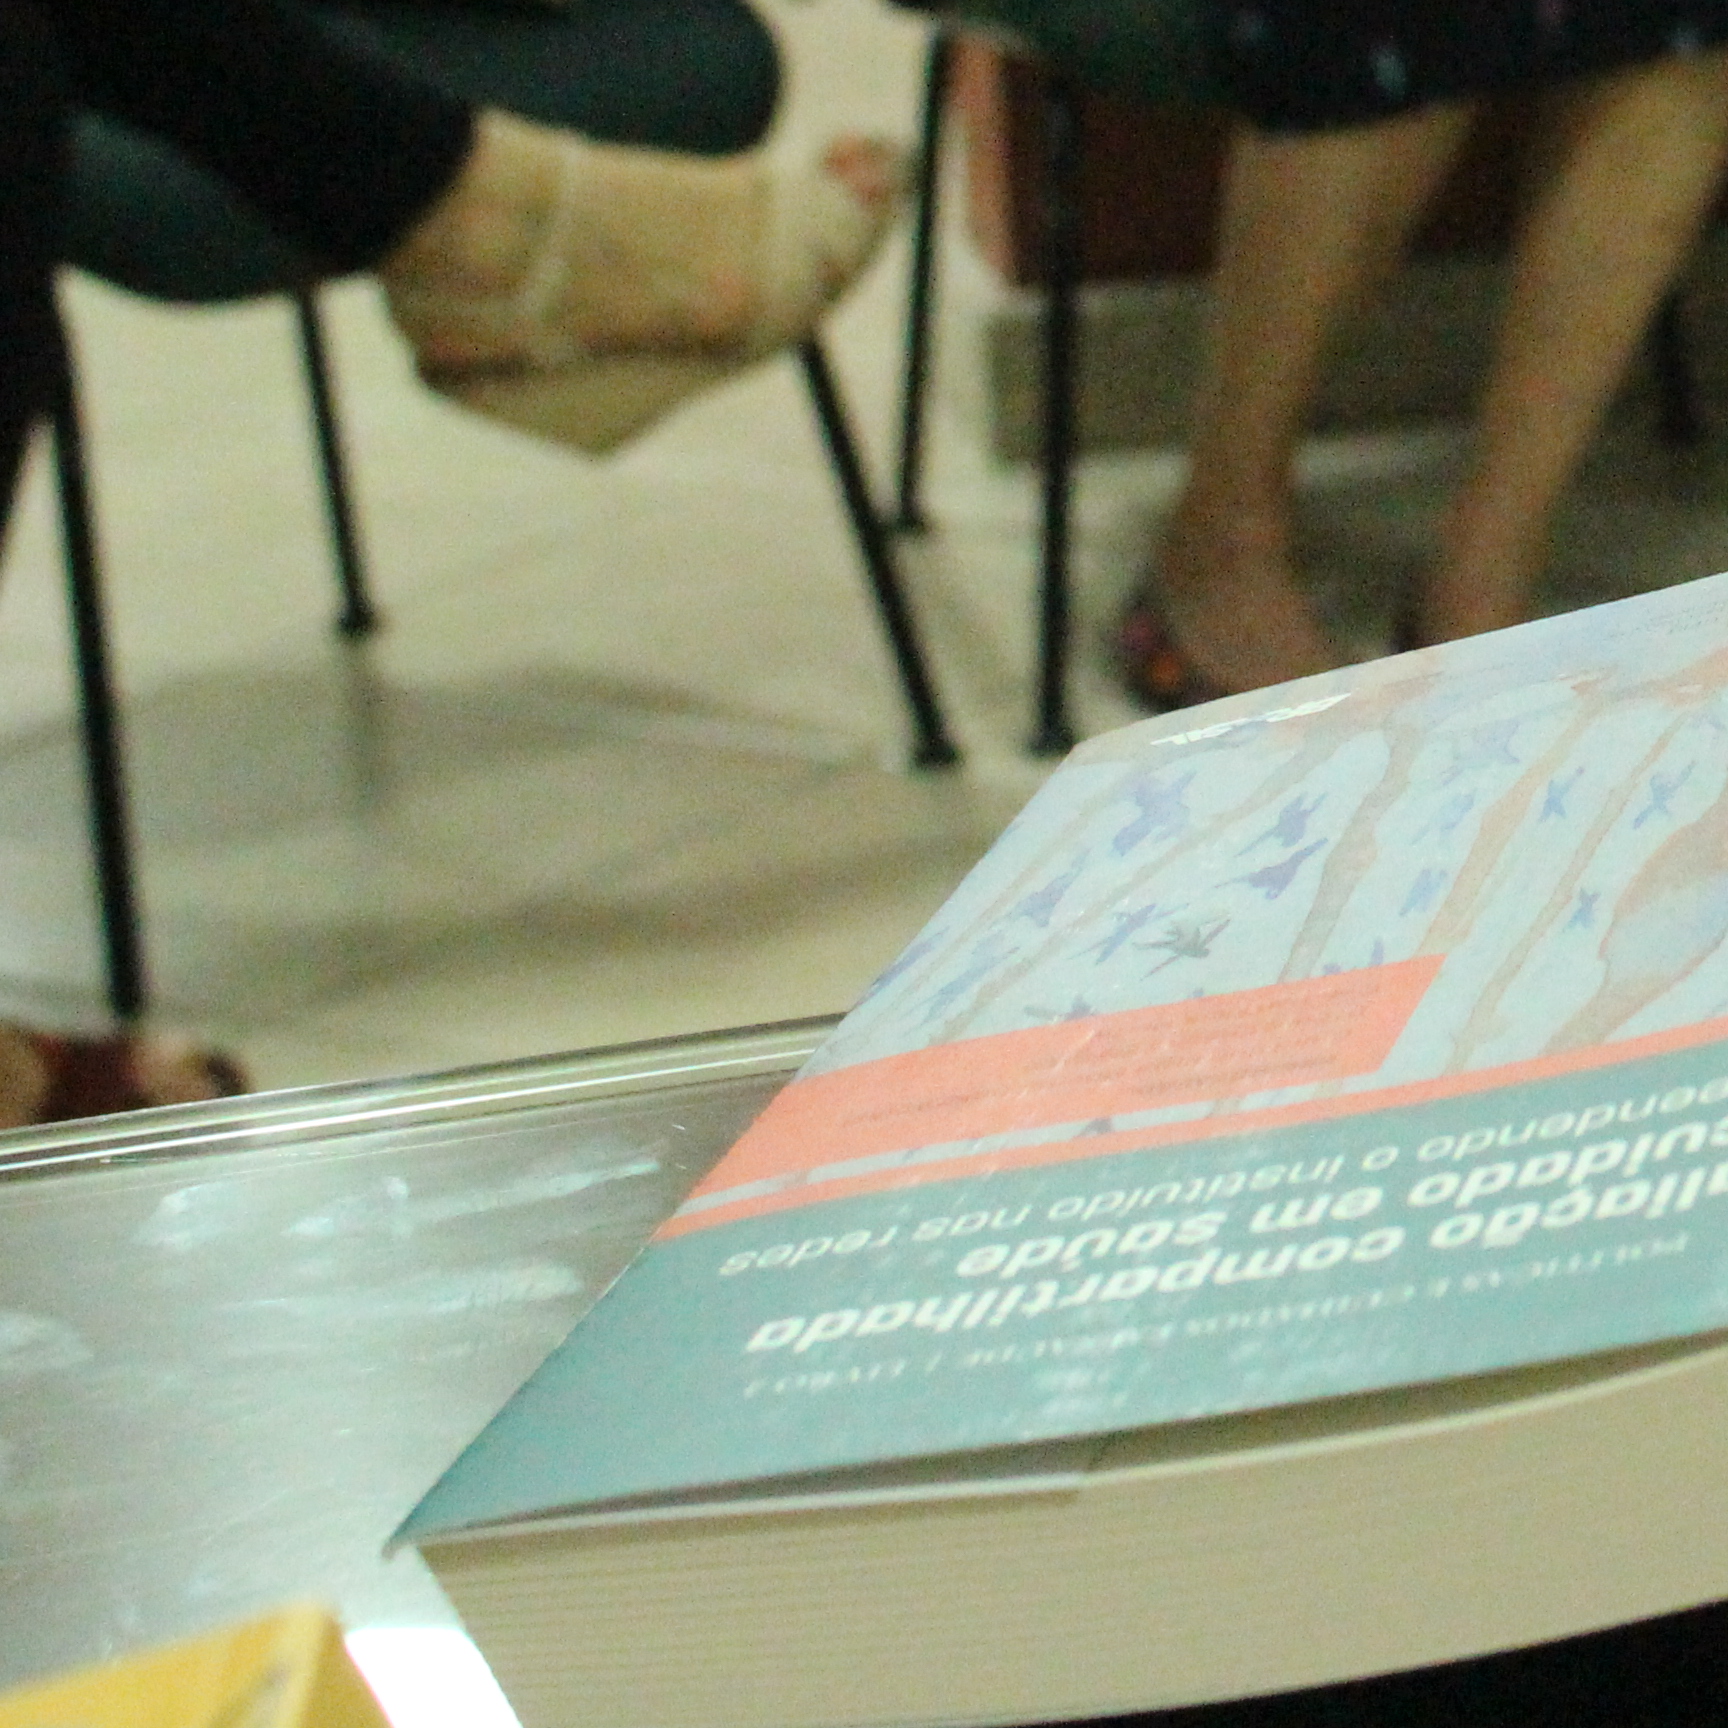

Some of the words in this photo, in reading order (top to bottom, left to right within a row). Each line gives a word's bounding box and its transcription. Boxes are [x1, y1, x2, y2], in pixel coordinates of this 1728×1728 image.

[1361, 1144, 1400, 1171] o
[1047, 1154, 1346, 1222] instituído
[1250, 1186, 1384, 1234] em
[911, 1204, 1031, 1242] nas
[955, 1210, 1228, 1279] saúde
[718, 1224, 899, 1277] redes
[744, 1225, 1405, 1354] compartilhada
